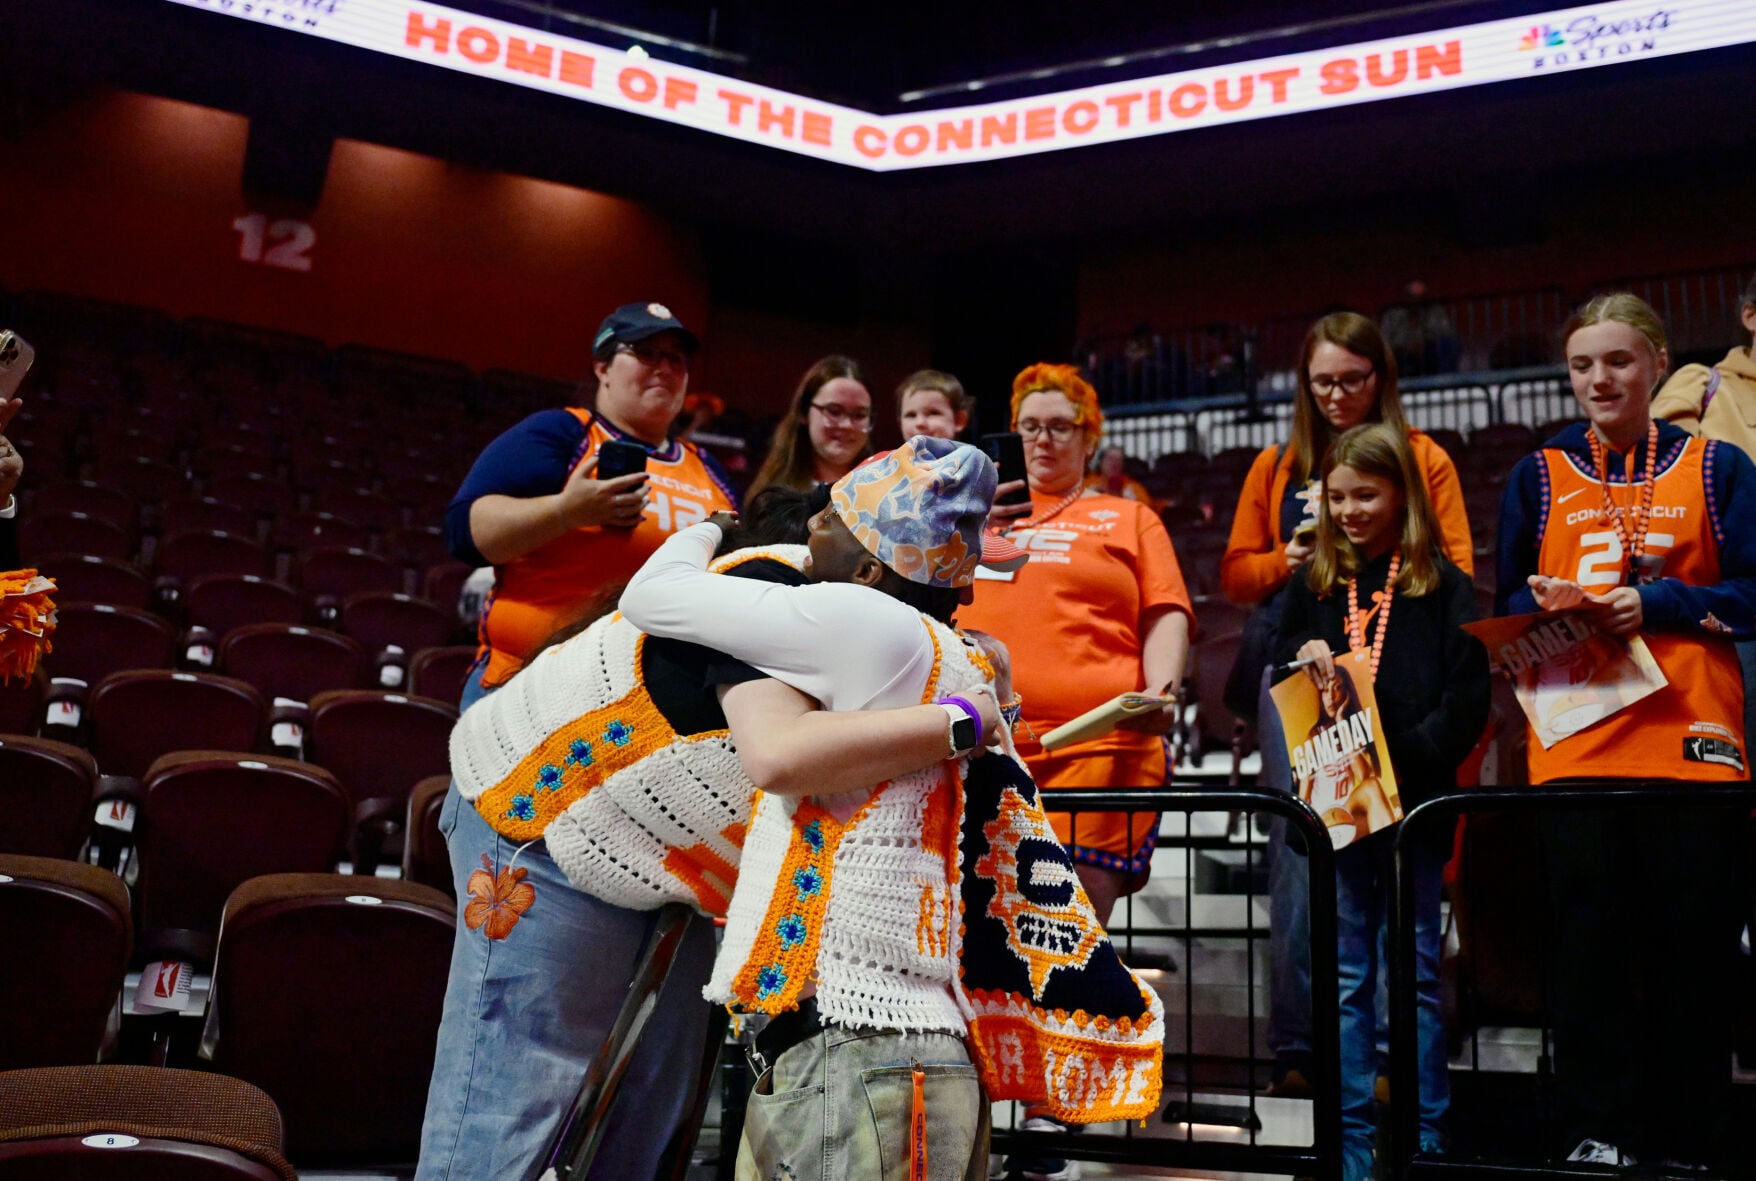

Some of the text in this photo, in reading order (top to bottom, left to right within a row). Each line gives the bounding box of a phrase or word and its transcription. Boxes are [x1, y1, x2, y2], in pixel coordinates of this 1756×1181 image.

[405, 11, 1463, 159] HOME OF THE CONNECTICUT SUN
[233, 214, 316, 272] 12
[1293, 706, 1374, 781] GAMEDAY
